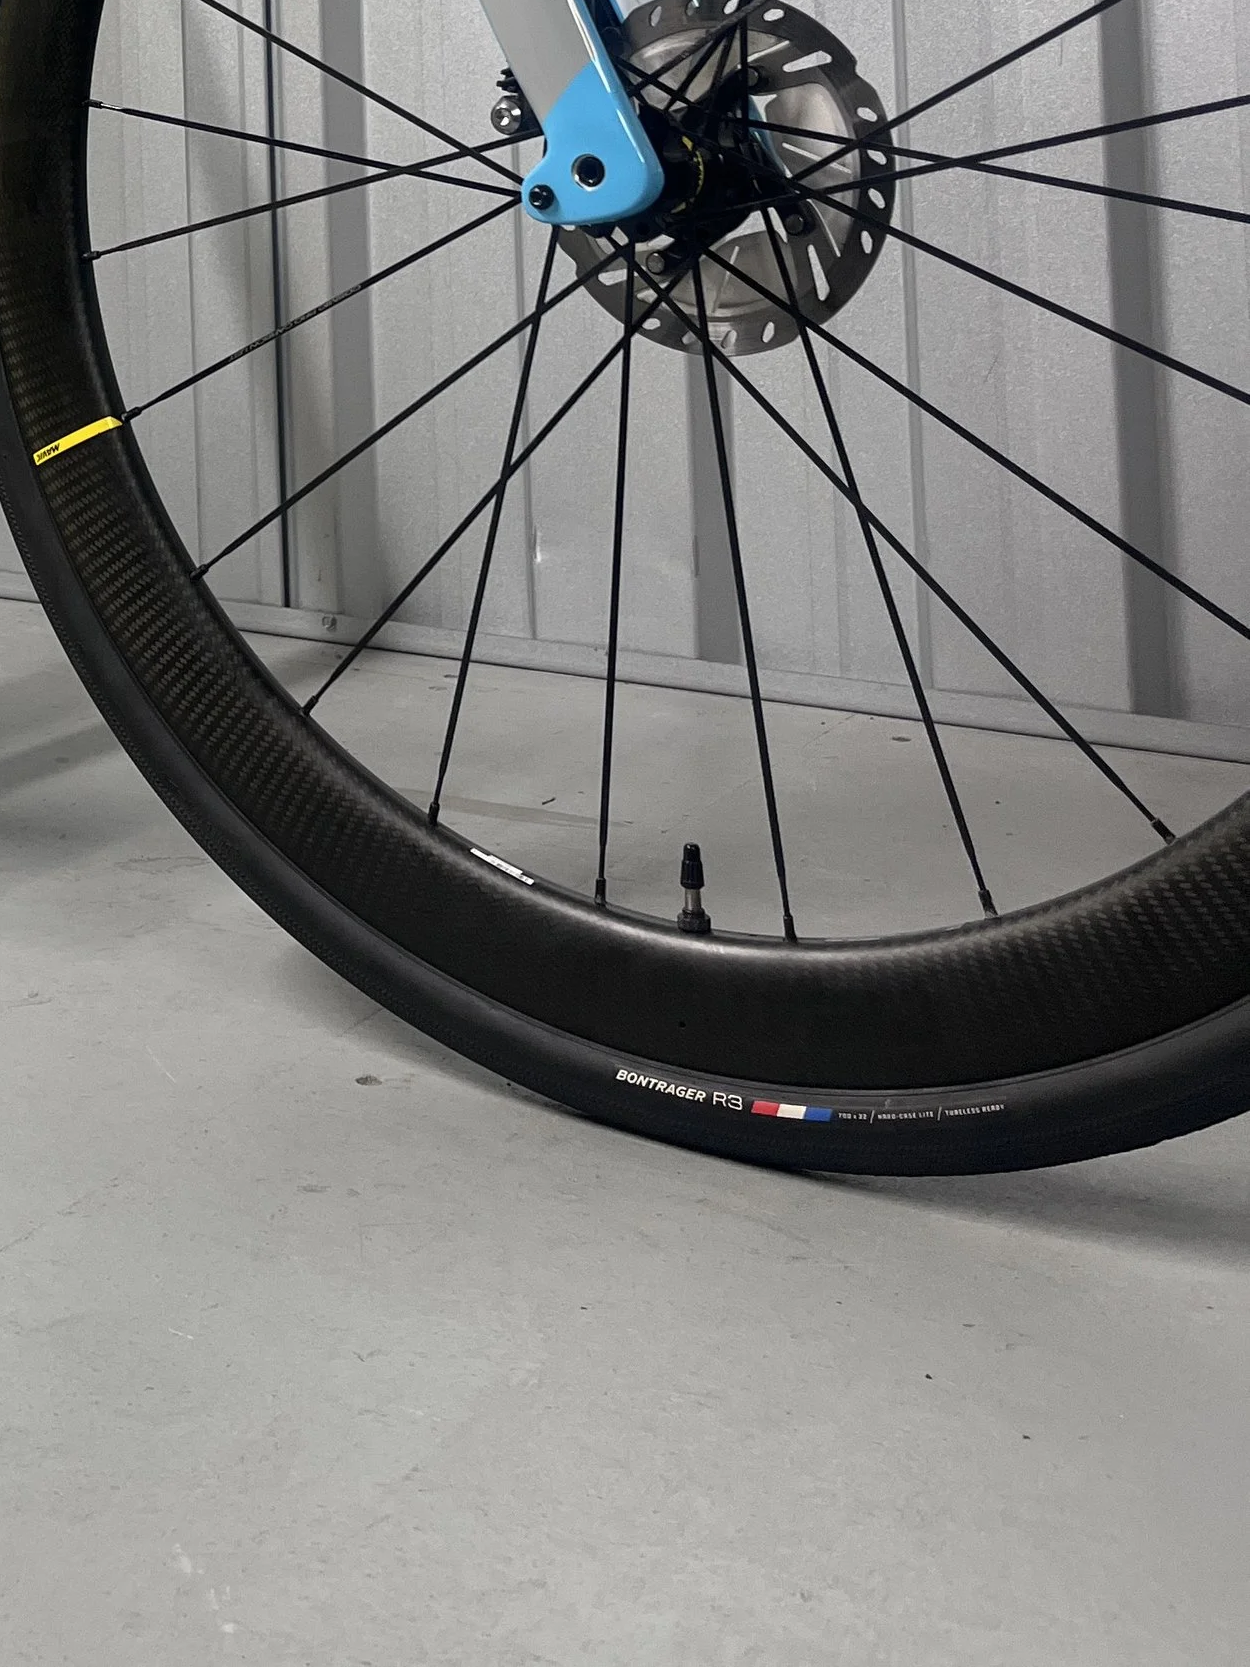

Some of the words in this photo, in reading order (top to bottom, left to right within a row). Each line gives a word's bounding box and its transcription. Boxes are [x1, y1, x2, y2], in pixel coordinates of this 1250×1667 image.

[36, 443, 61, 463] MAVIC
[615, 1068, 707, 1103] BONTRAGER
[712, 1091, 744, 1111] R3
